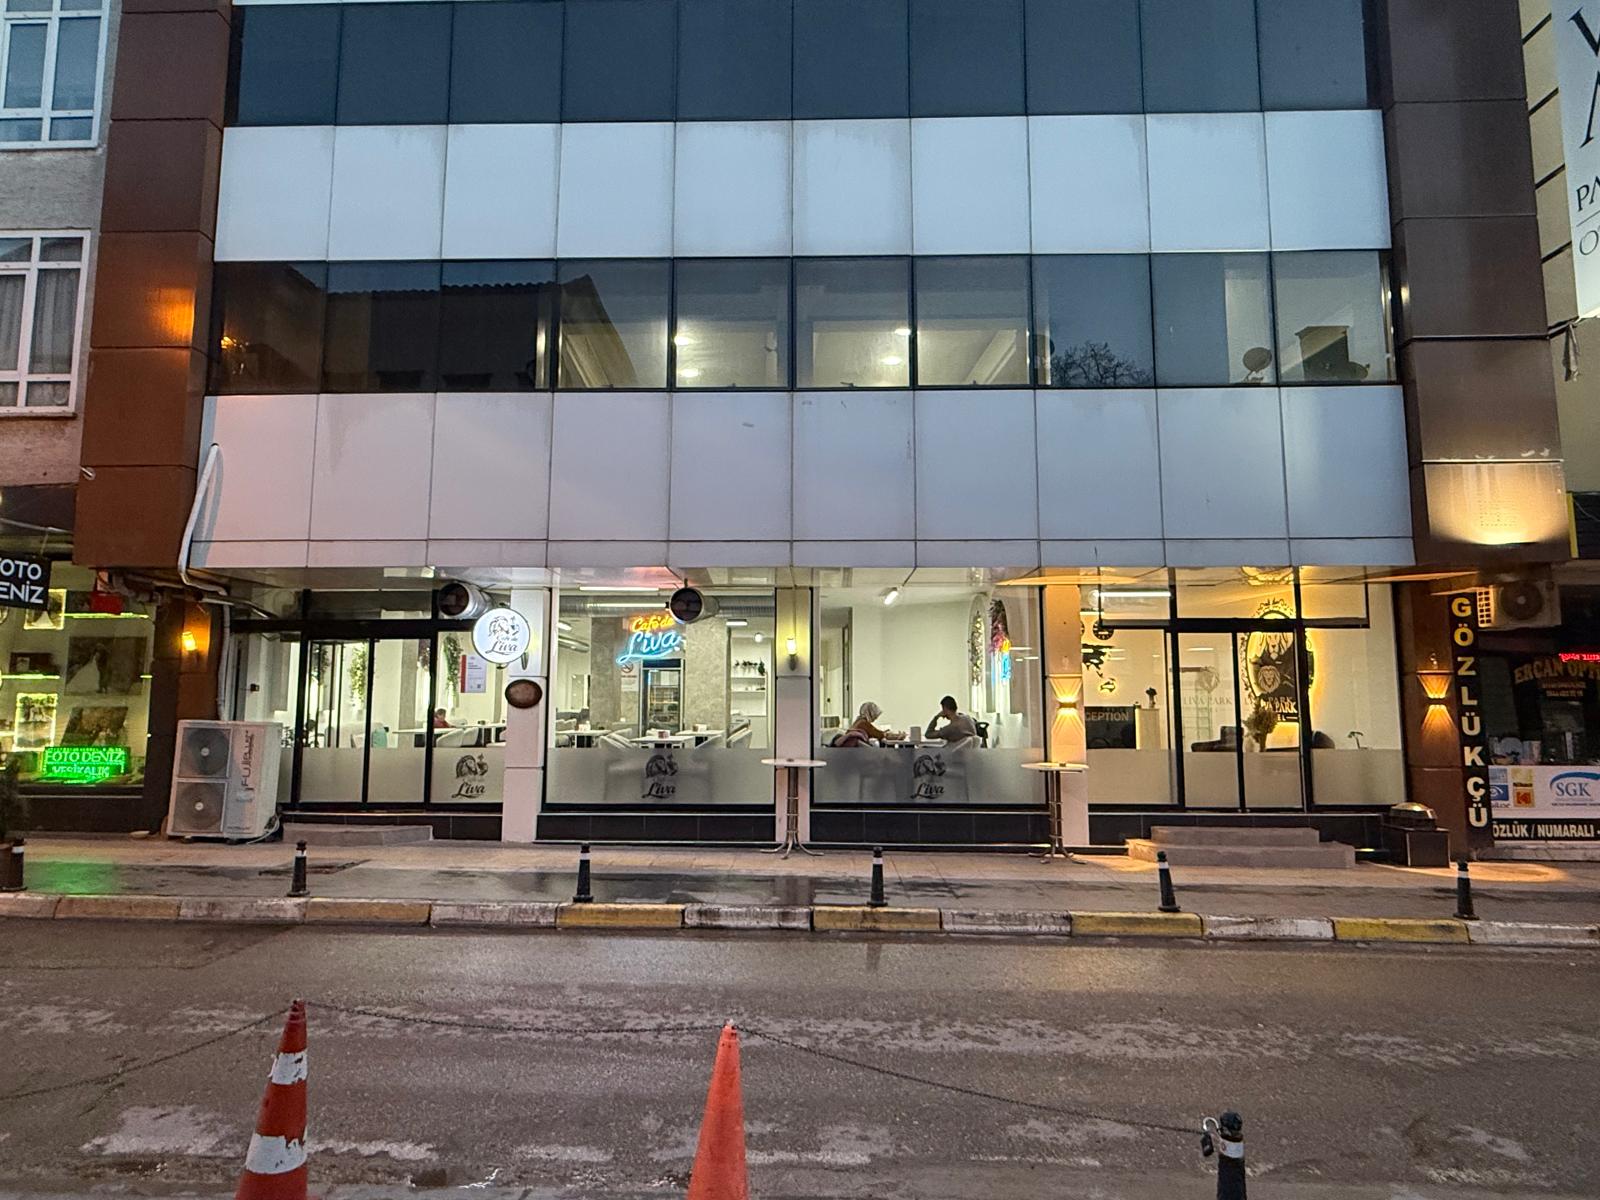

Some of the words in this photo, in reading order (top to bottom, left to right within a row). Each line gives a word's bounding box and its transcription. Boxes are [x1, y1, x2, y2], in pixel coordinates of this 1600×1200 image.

[0, 557, 42, 580] OTO
[0, 581, 44, 604] ENİZ
[485, 640, 518, 656] Liva
[616, 630, 682, 664] Liva
[1451, 596, 1488, 828] GÖZLÜKÇÜ
[46, 749, 80, 762] FOTO
[451, 781, 486, 799] Liva
[642, 782, 676, 798] Liva
[910, 782, 945, 799] Liva
[1556, 782, 1592, 797] SGK
[1492, 820, 1529, 837] ÖZLÜK
[1537, 824, 1595, 837] NUMARALI
